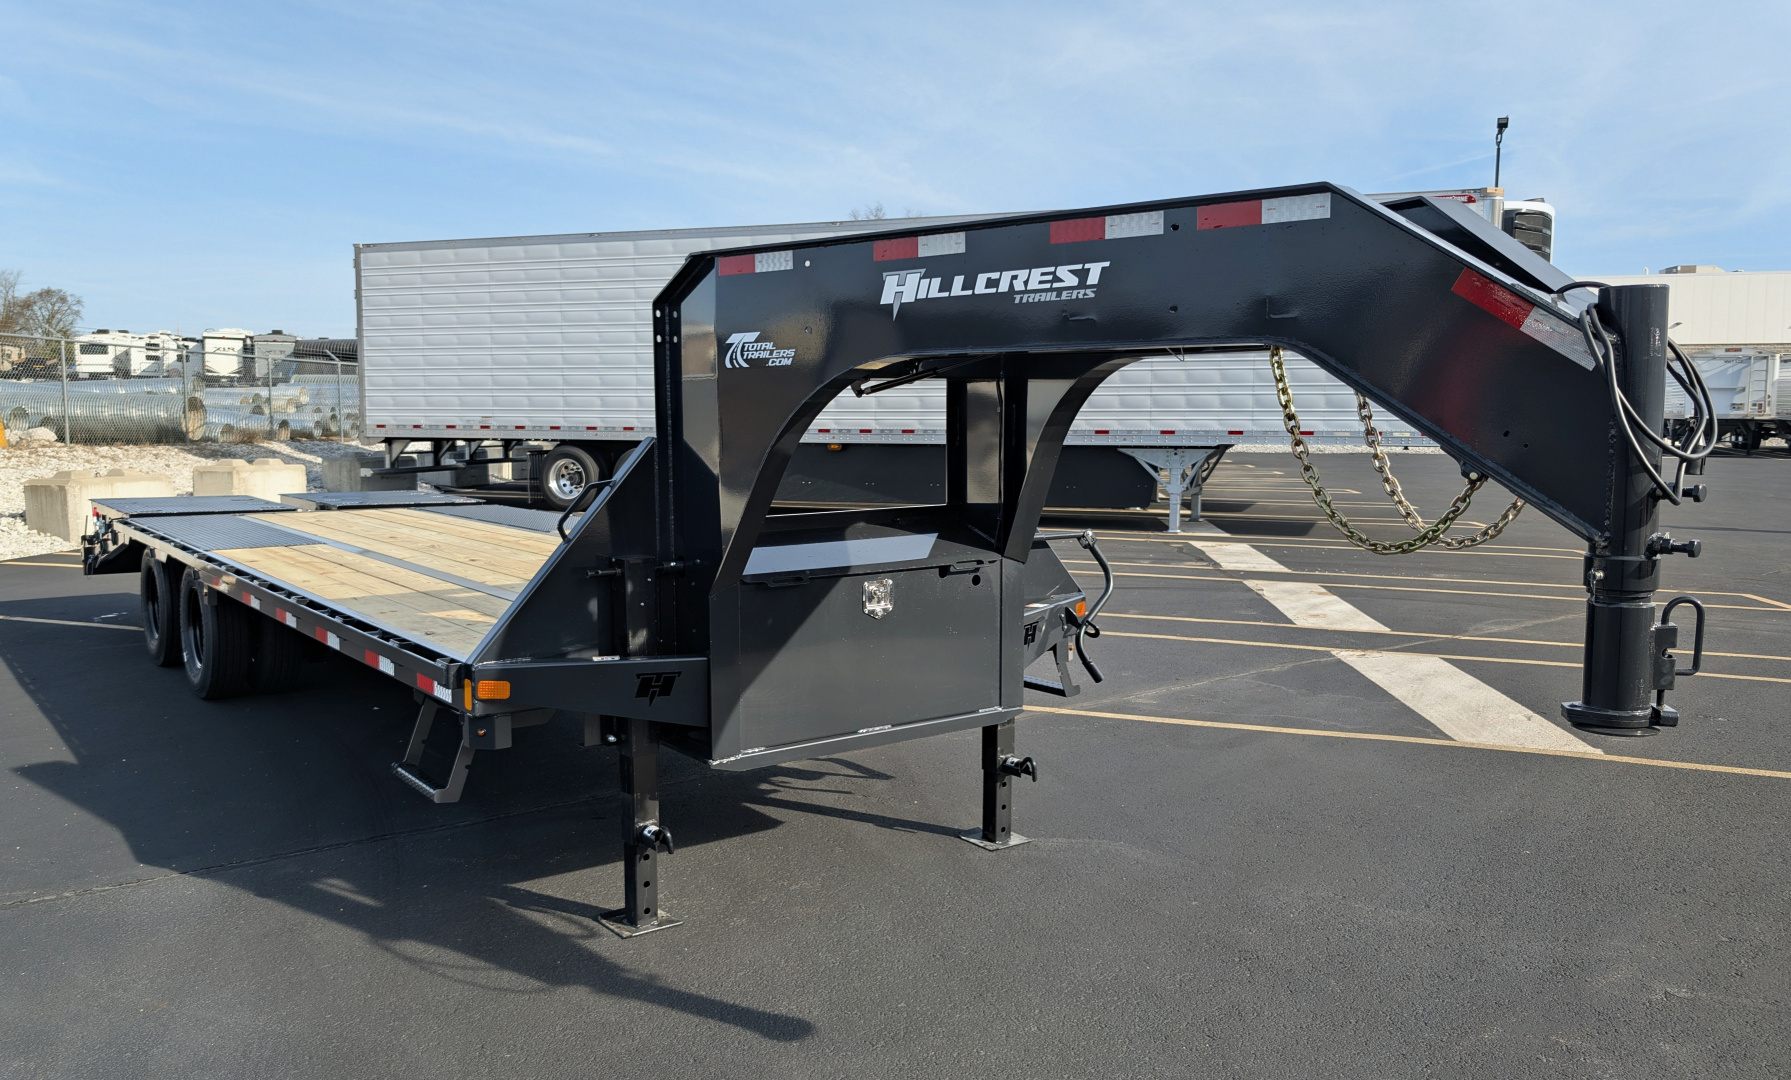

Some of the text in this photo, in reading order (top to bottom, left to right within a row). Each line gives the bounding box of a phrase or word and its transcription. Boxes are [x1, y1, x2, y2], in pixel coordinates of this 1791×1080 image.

[880, 261, 1111, 305] HILLCREST
[1013, 288, 1097, 304] TRAILERS
[743, 342, 776, 351] TOTAL
[743, 349, 796, 359] TRAILERS
[766, 358, 793, 367] .COM
